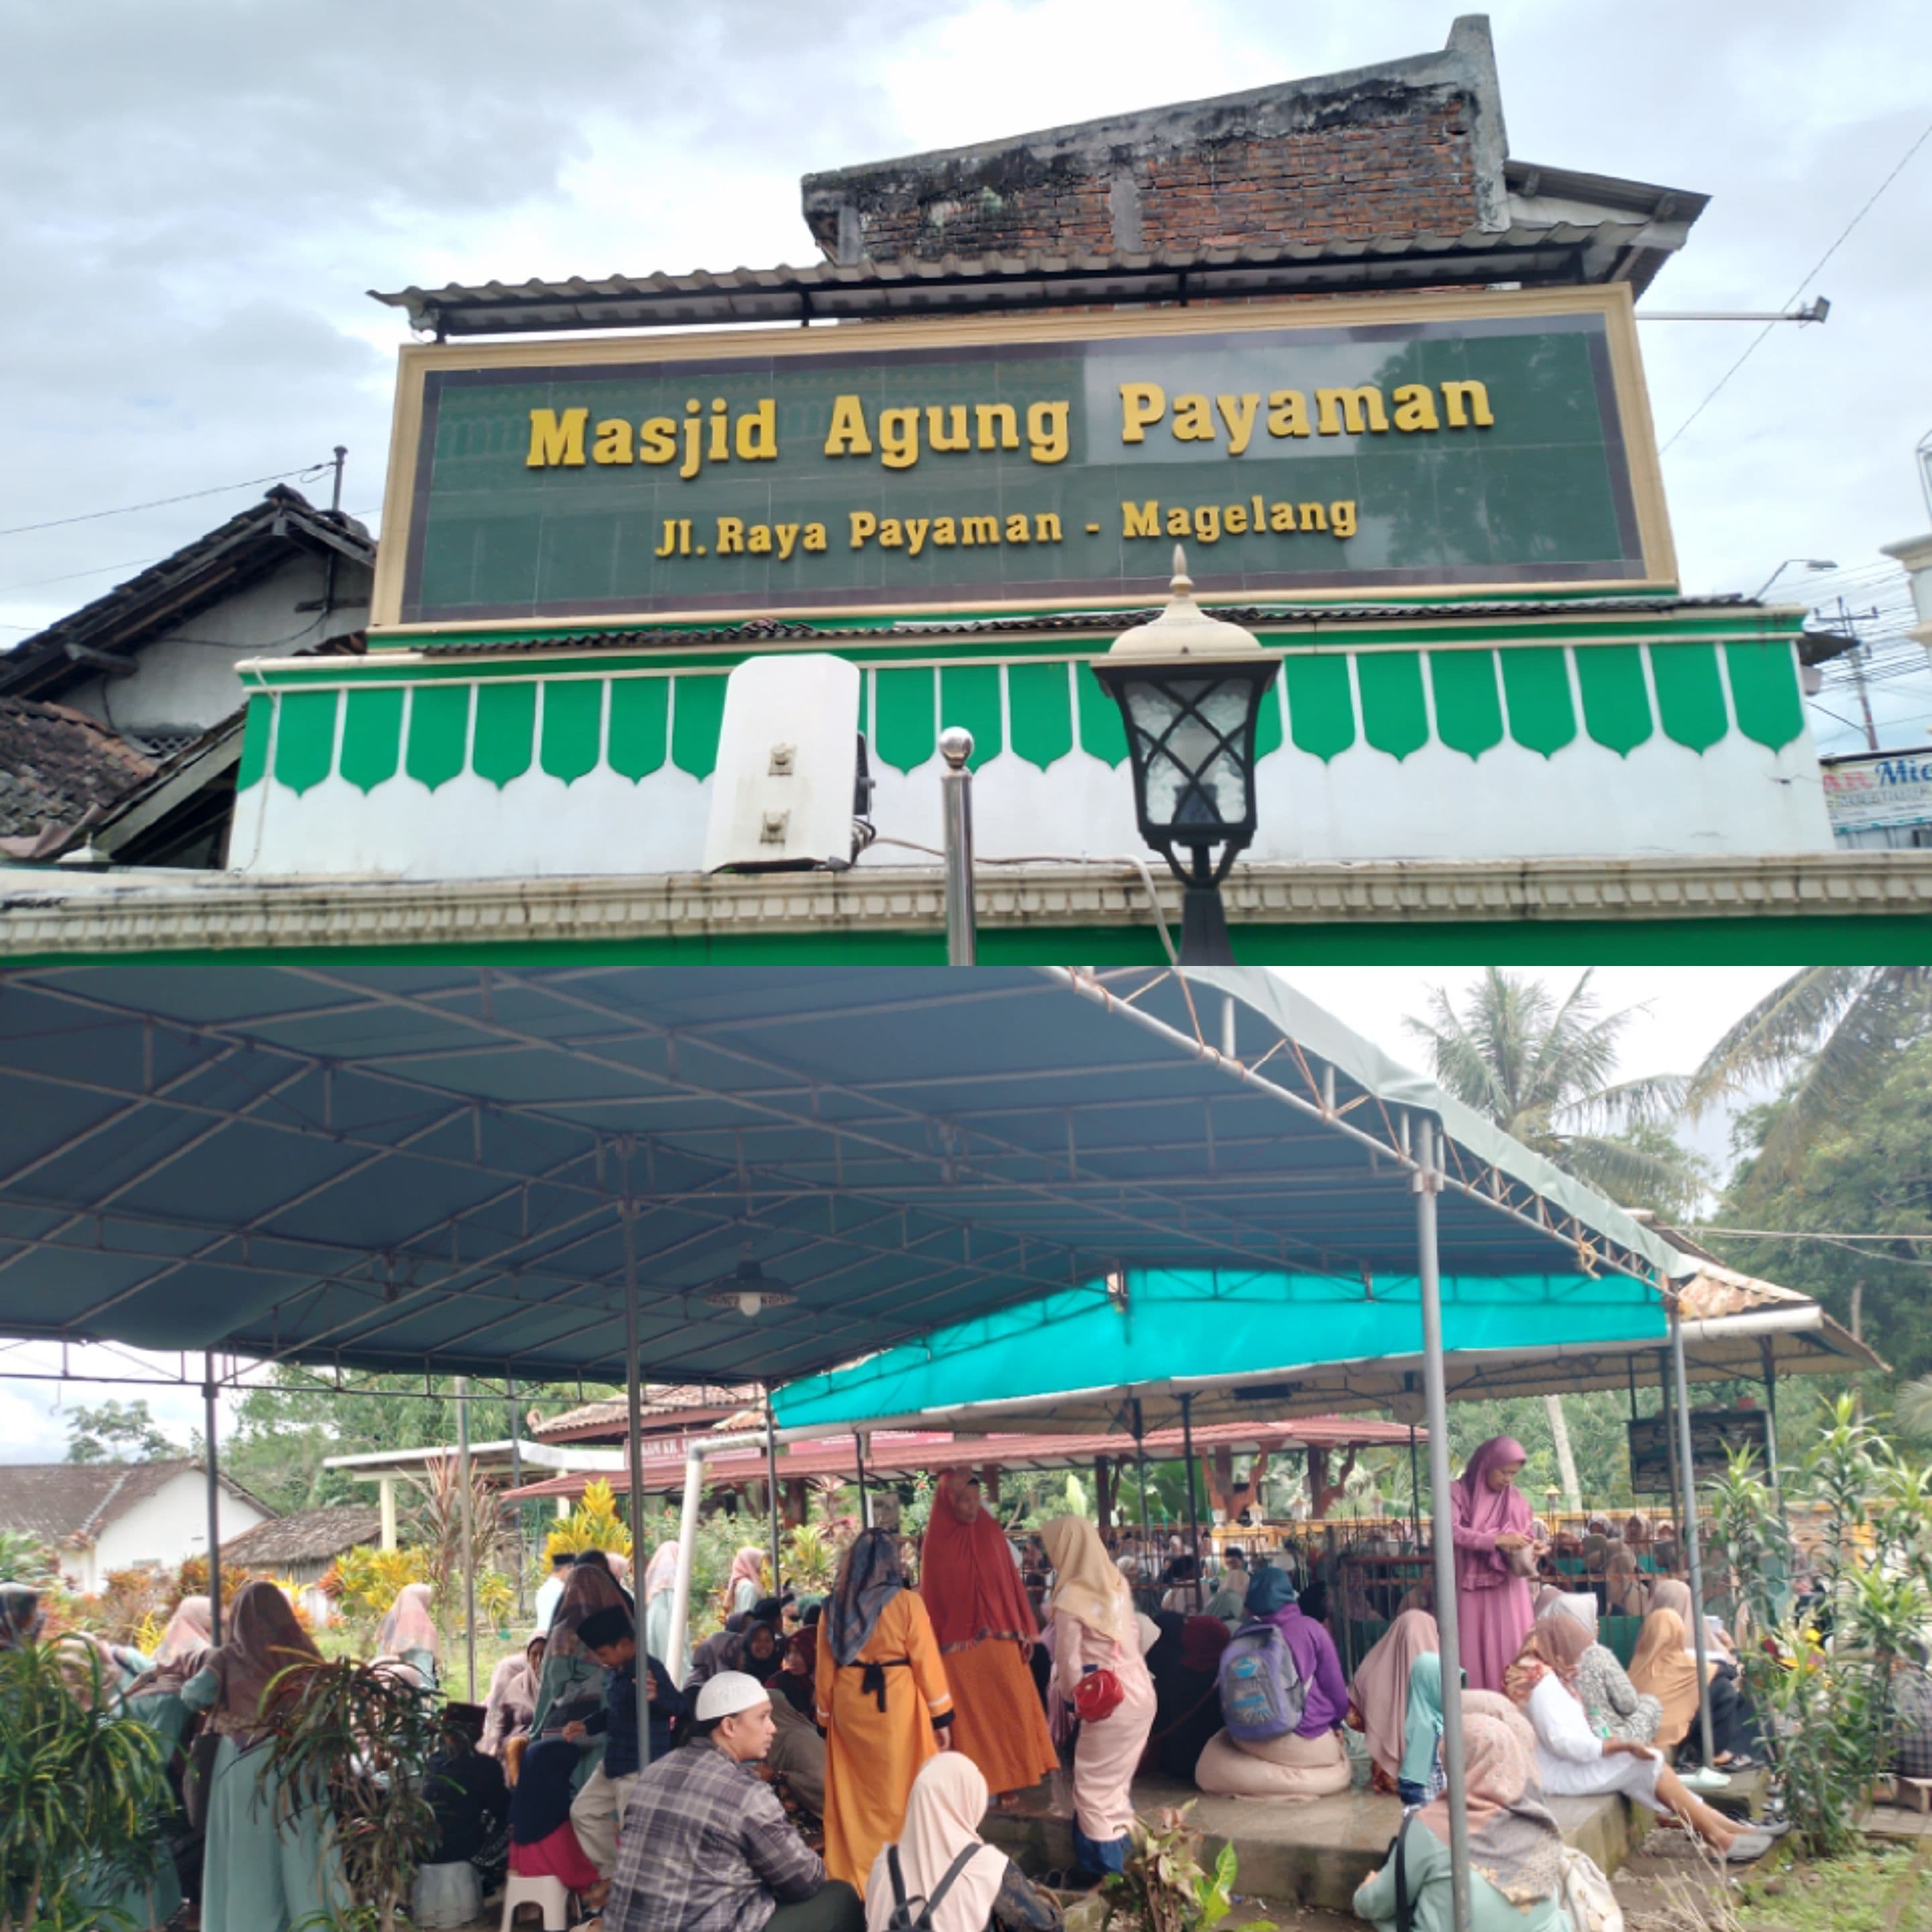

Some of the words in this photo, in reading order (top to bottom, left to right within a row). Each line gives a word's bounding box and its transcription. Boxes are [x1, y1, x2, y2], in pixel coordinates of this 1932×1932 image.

[526, 398, 778, 478] Masjid
[823, 395, 1069, 469] Agung
[1119, 380, 1494, 454] Payaman
[655, 519, 706, 557] Jl.
[716, 518, 827, 559] Raya
[850, 511, 1063, 555] Payaman
[1122, 496, 1357, 542] Magelang
